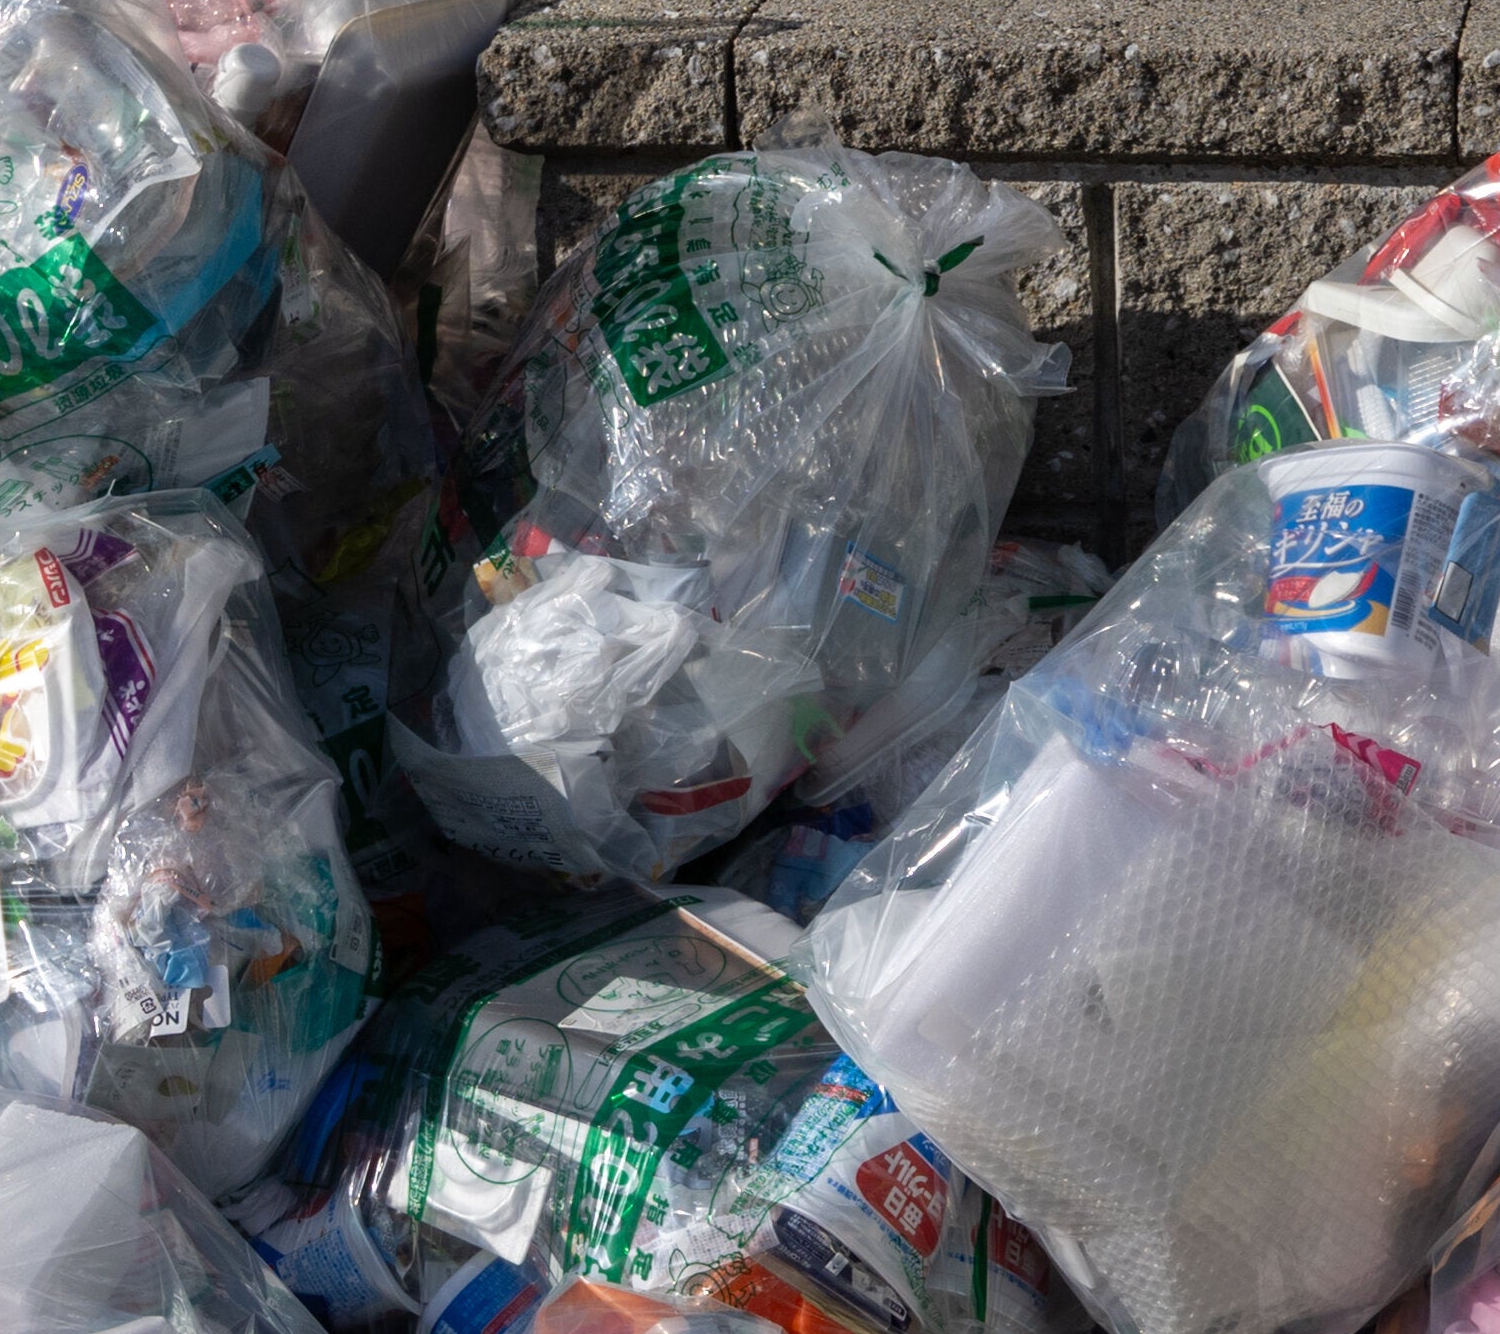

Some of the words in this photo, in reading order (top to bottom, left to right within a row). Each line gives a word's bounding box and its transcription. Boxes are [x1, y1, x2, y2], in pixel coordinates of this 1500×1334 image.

[1296, 490, 1364, 524] 至福の
[882, 1185, 925, 1236] 毎日
[884, 1151, 947, 1221] ヨーグルト
